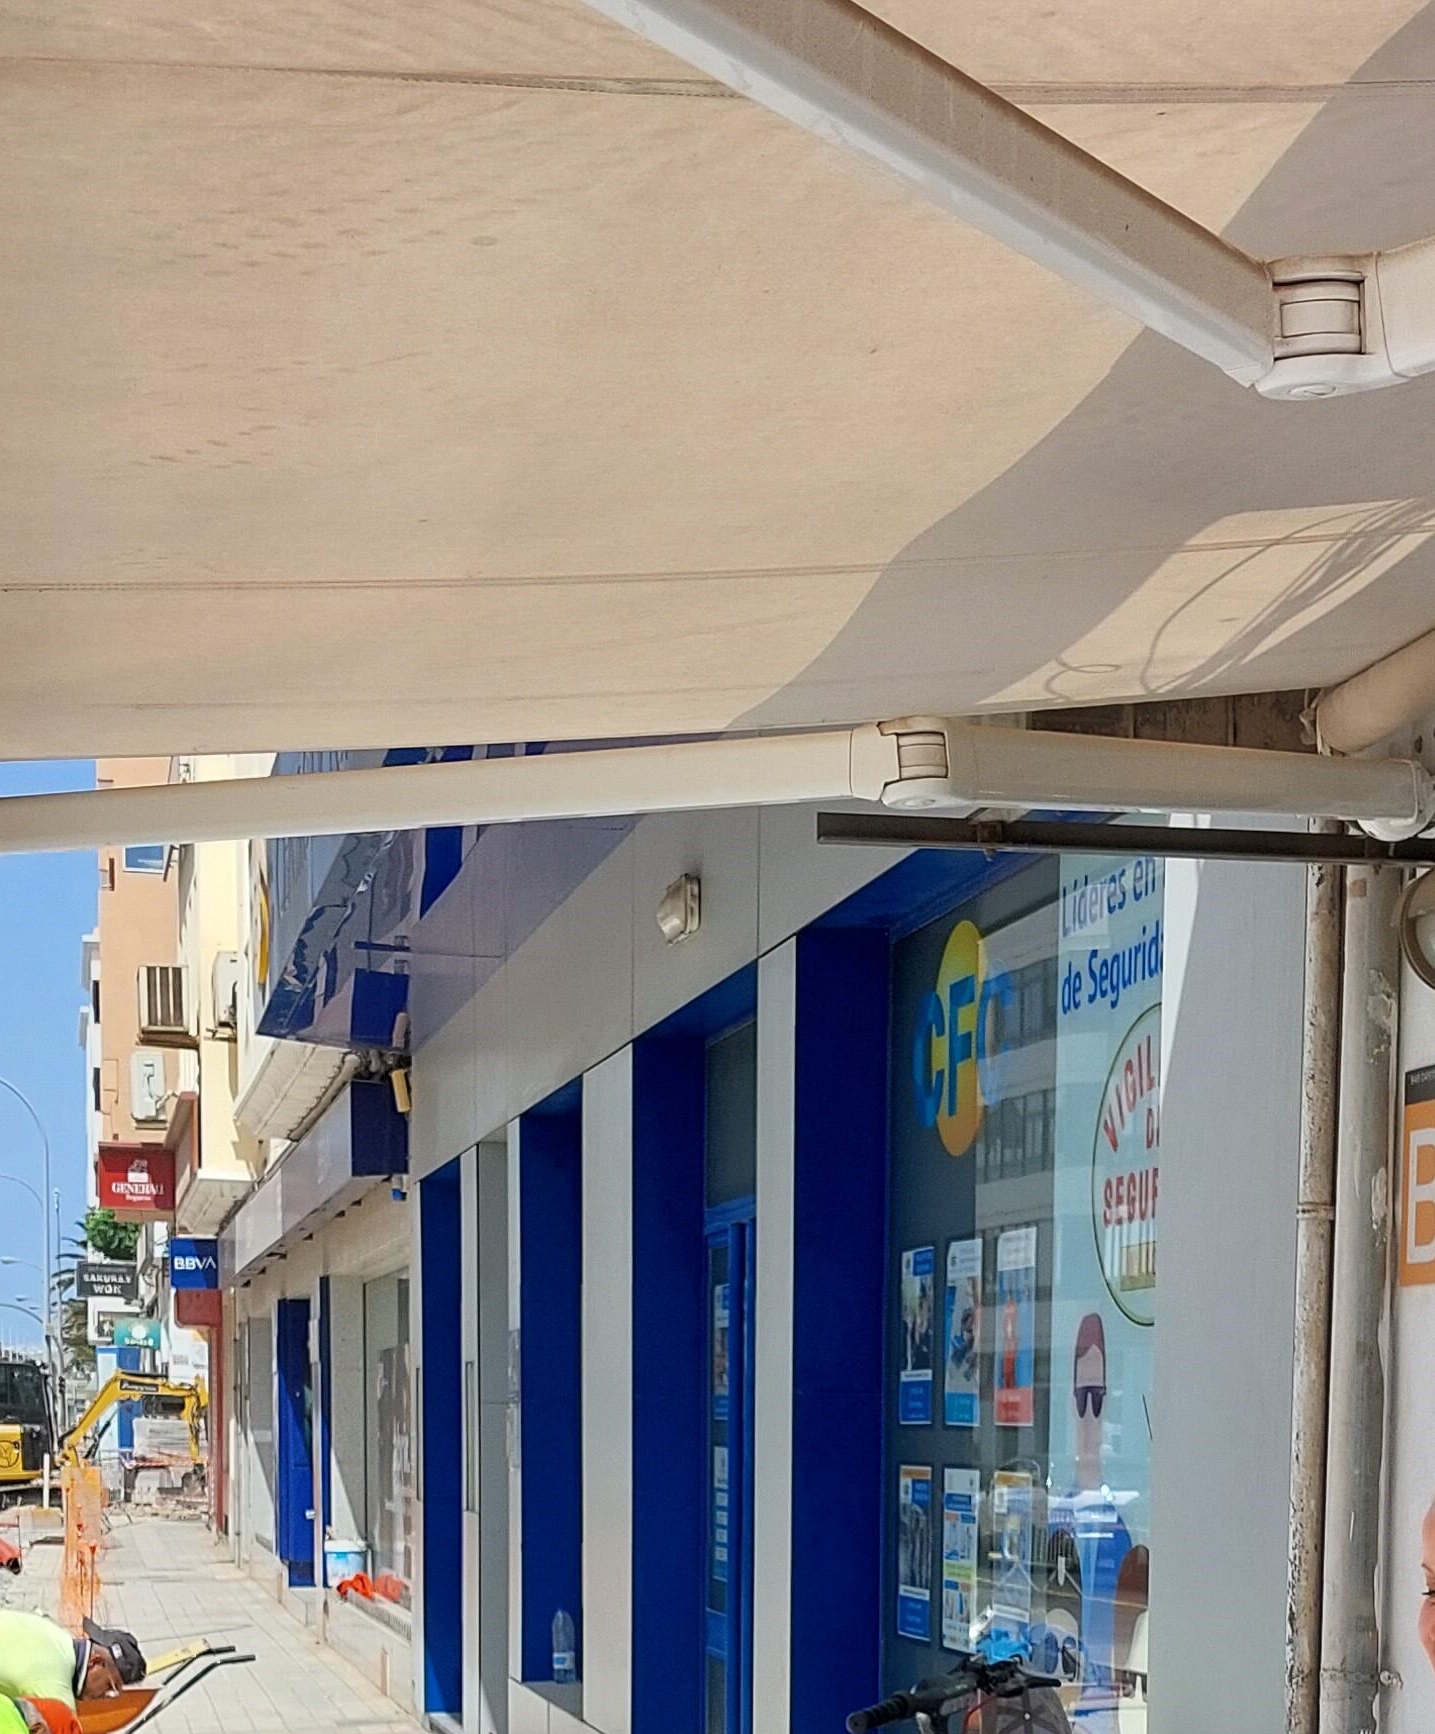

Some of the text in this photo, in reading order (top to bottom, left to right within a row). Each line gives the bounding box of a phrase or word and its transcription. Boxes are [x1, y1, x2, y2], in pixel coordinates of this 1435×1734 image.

[1132, 857, 1156, 901] en
[1062, 960, 1083, 1015] de
[174, 1256, 217, 1271] BBVA
[93, 1284, 122, 1294] WOK
